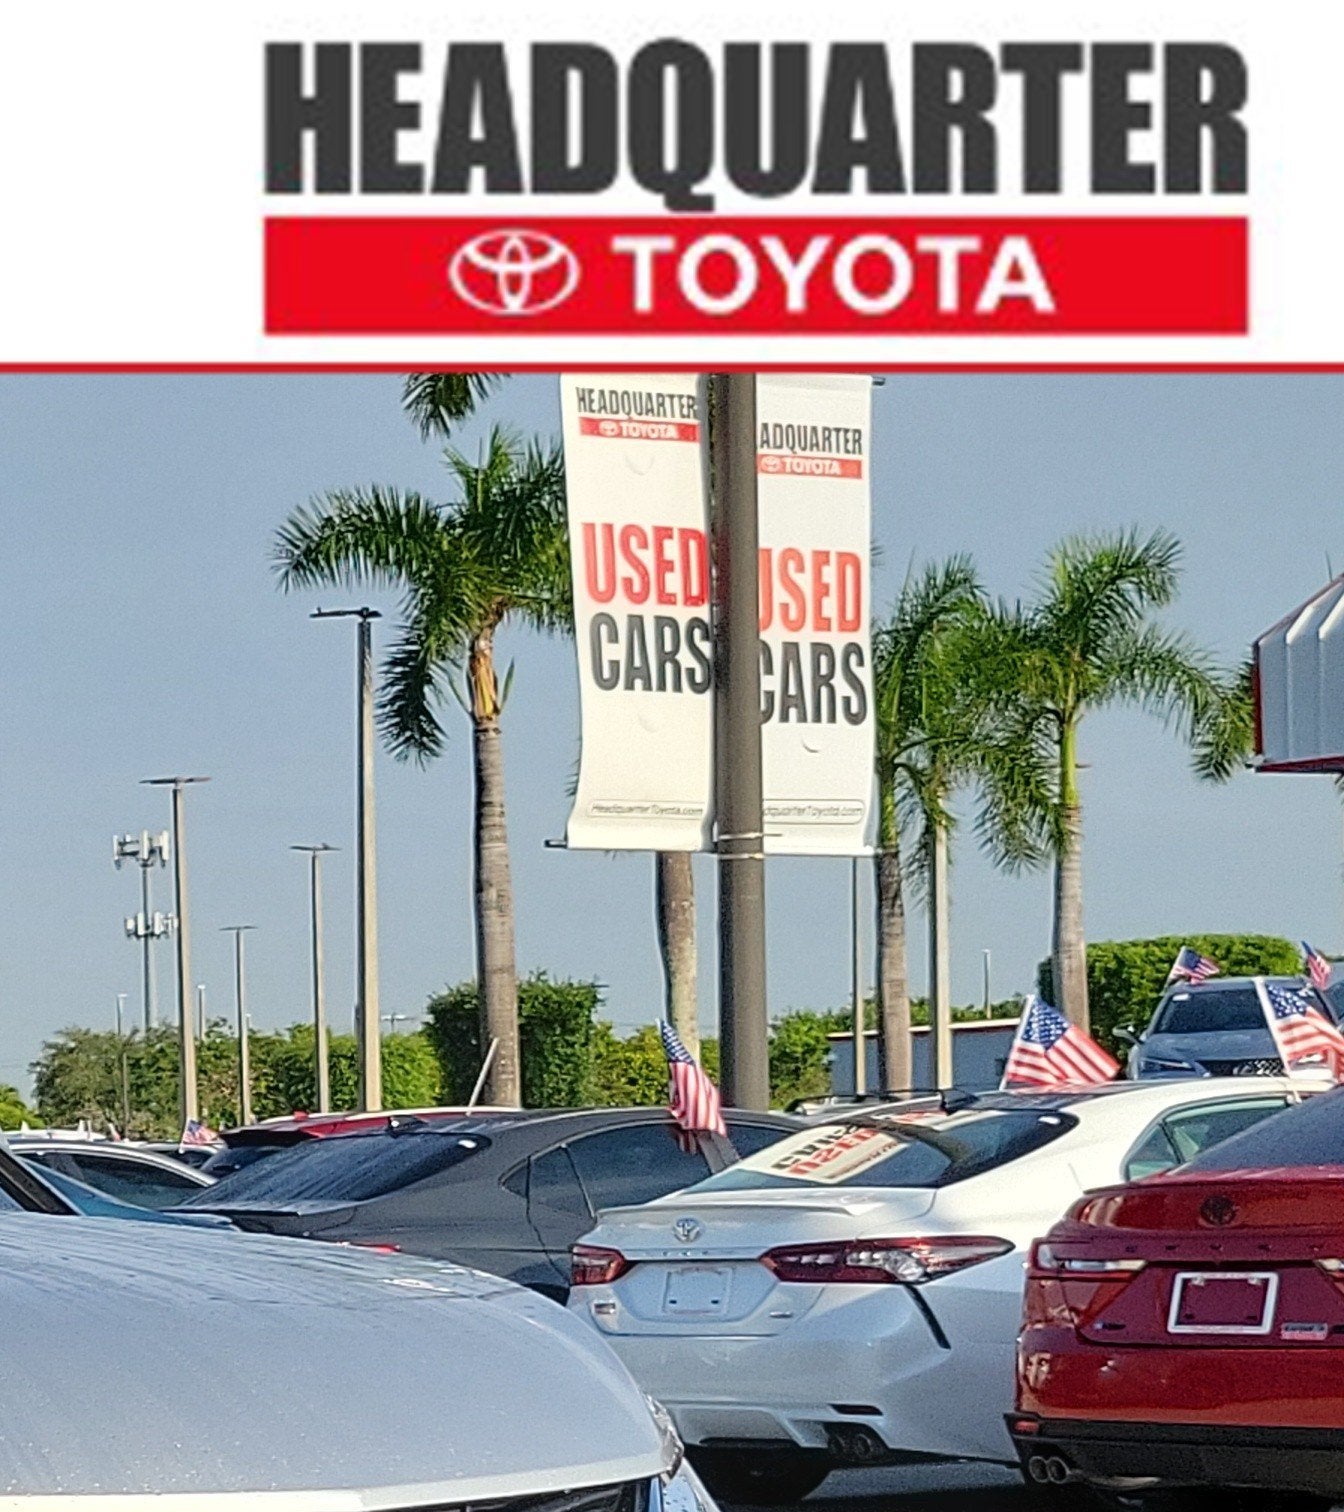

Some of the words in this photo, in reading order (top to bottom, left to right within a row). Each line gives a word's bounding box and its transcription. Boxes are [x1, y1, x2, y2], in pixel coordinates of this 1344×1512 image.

[576, 387, 698, 420] HEADQUARTER
[619, 422, 678, 440] TOYOTA
[759, 422, 863, 455] ADQUARTER
[783, 459, 842, 475] TOYOTA
[581, 522, 710, 607] USED
[589, 612, 712, 695] CARS
